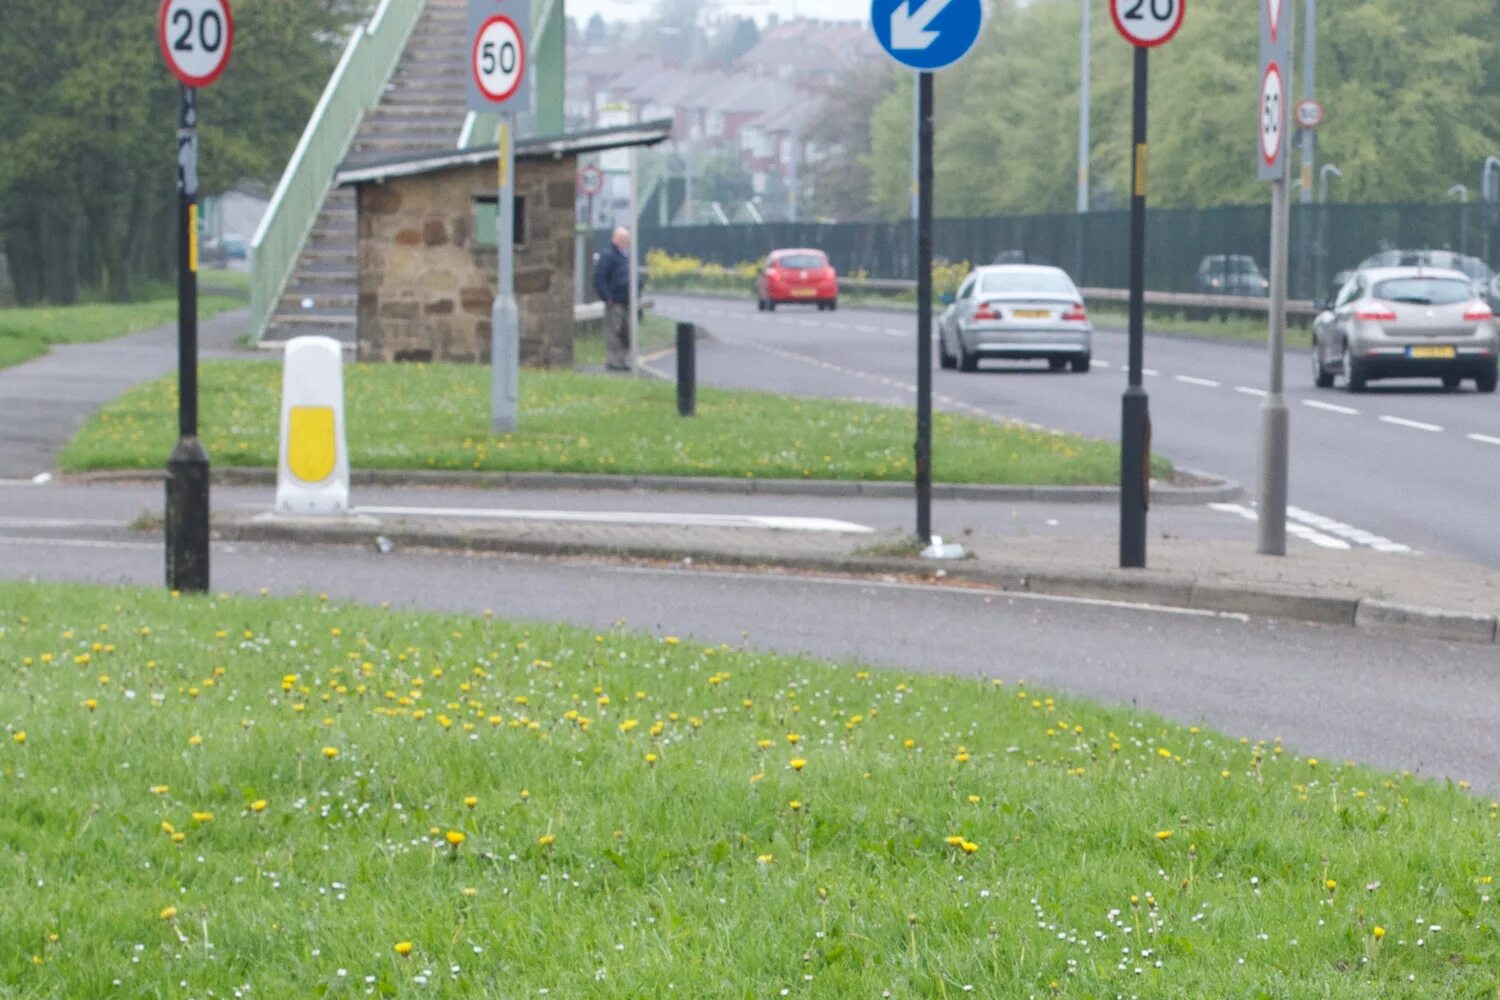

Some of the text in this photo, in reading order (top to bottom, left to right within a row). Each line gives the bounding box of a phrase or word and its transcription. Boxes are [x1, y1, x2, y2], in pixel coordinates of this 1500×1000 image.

[172, 8, 222, 53] 20
[482, 41, 516, 75] 50
[1265, 93, 1279, 133] 50
